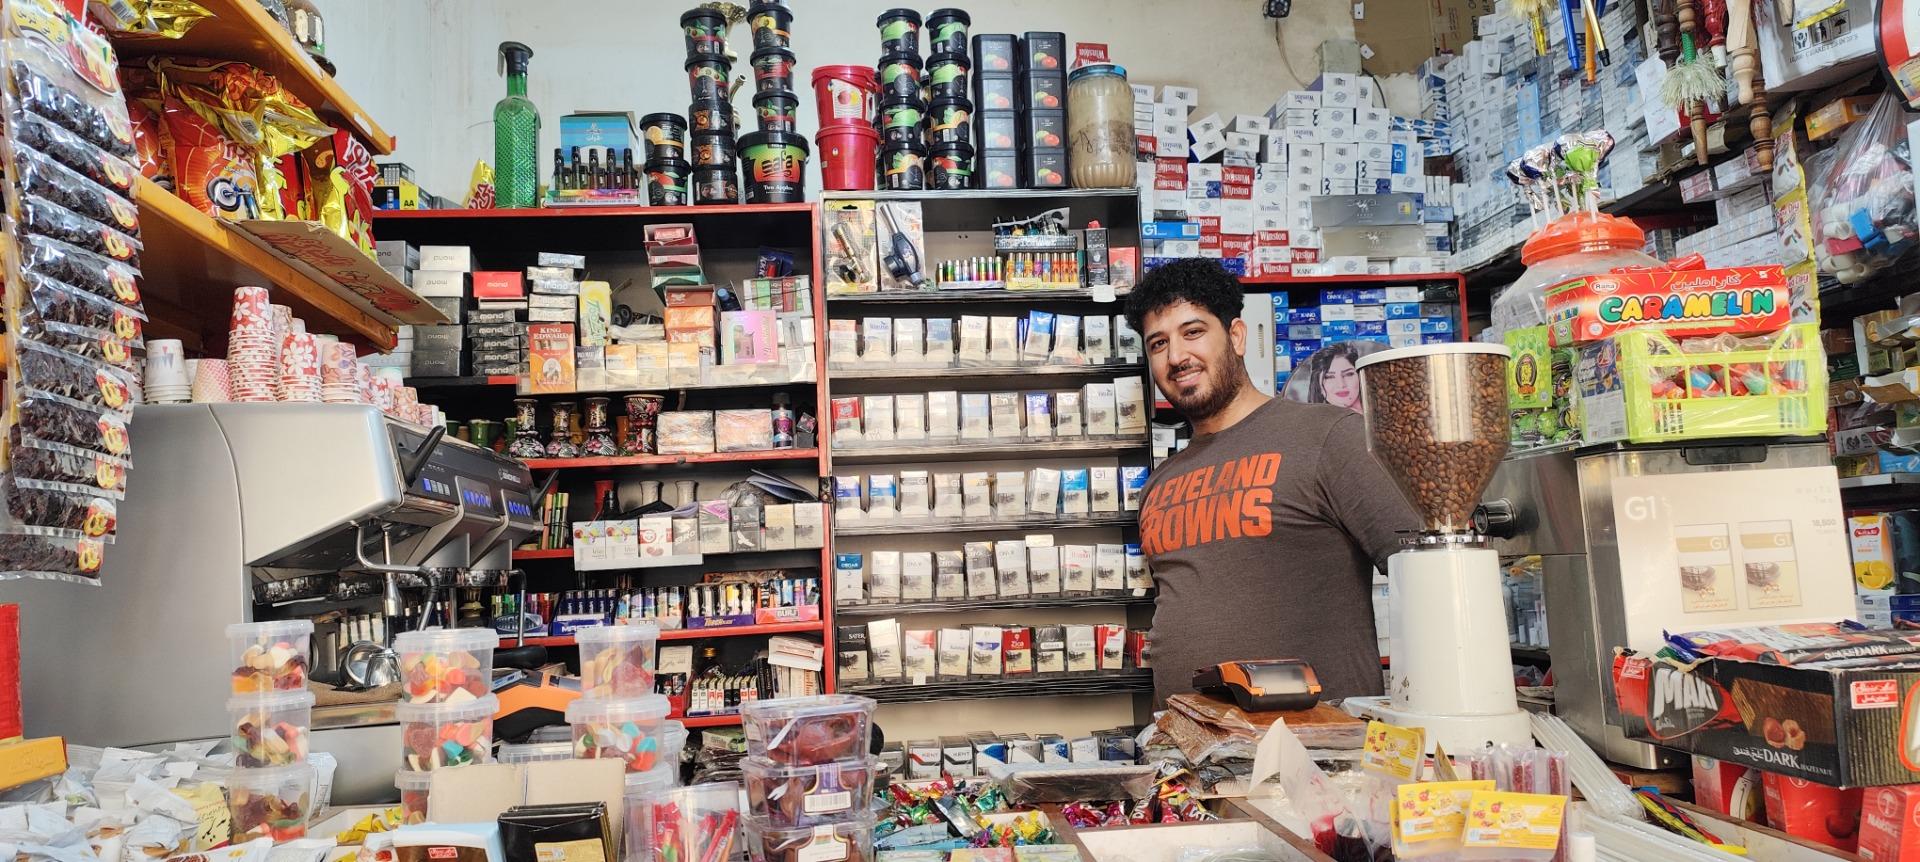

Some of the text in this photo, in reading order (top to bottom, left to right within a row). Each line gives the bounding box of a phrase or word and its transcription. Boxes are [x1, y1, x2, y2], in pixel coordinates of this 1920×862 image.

[1223, 186, 1249, 196] Winston
[1143, 225, 1158, 236] G1
[1260, 232, 1287, 242] Winston
[1263, 264, 1290, 274] Winston
[1392, 305, 1405, 315] G1
[1599, 288, 1775, 323] CARAMELIN
[479, 311, 504, 320] mond
[479, 326, 504, 334] mond
[483, 340, 508, 348] mond
[484, 353, 509, 361] mond
[484, 366, 510, 375] mond
[1624, 495, 1657, 521] G1
[1709, 537, 1728, 550] G1
[1774, 533, 1793, 547] G1
[1855, 643, 1887, 657] DARK
[1652, 666, 1719, 720] MAKI
[1763, 748, 1801, 768] DARK
